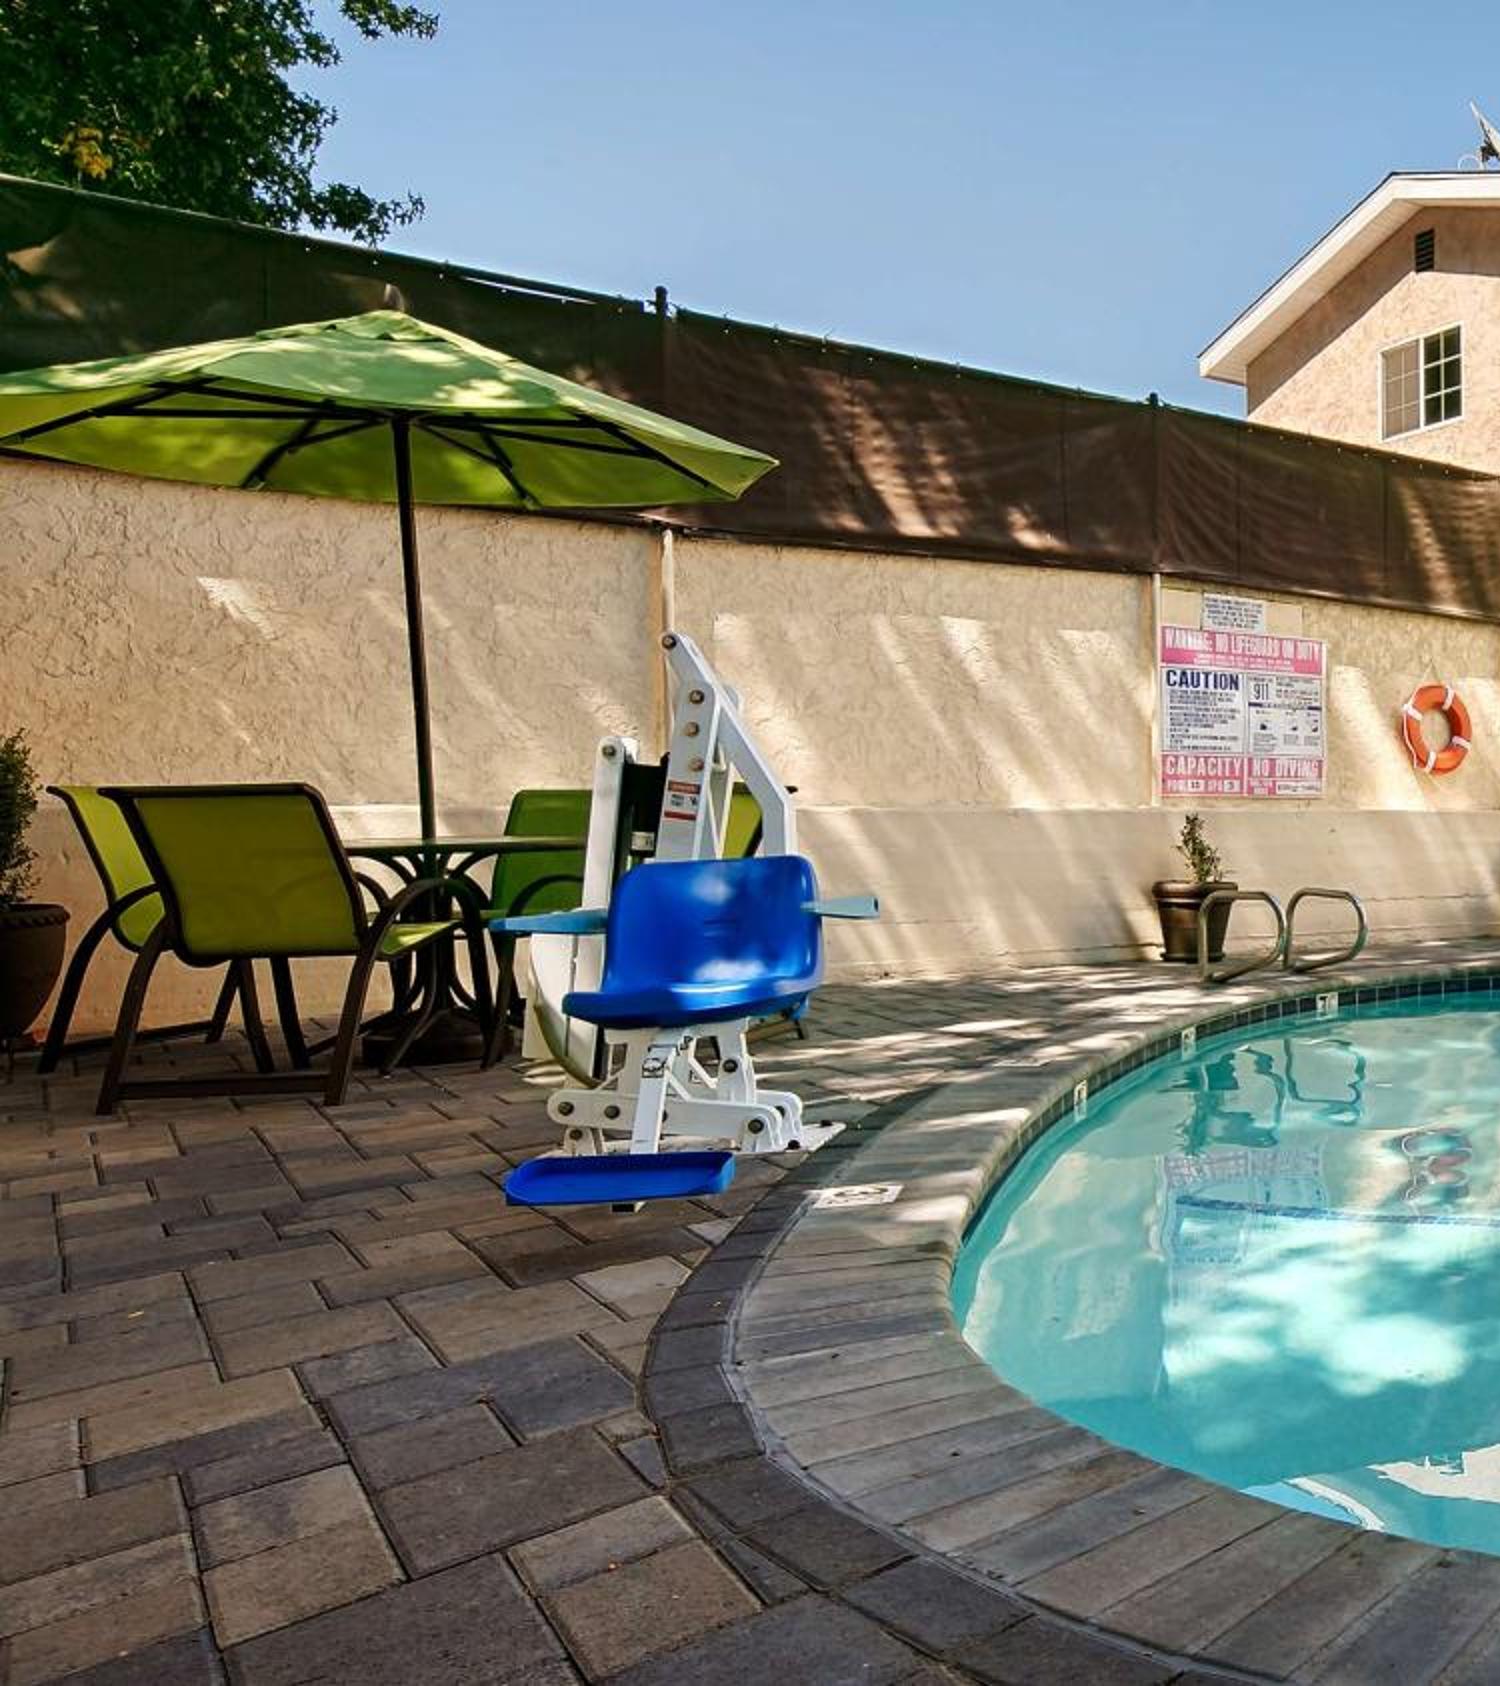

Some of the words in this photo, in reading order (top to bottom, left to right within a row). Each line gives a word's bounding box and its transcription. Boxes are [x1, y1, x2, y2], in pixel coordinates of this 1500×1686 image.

[1167, 670, 1239, 690] CAUTION
[1254, 683, 1268, 700] 911
[1166, 755, 1241, 777] CAPACITY
[1252, 757, 1270, 777] NO
[1275, 758, 1319, 778] DIVING
